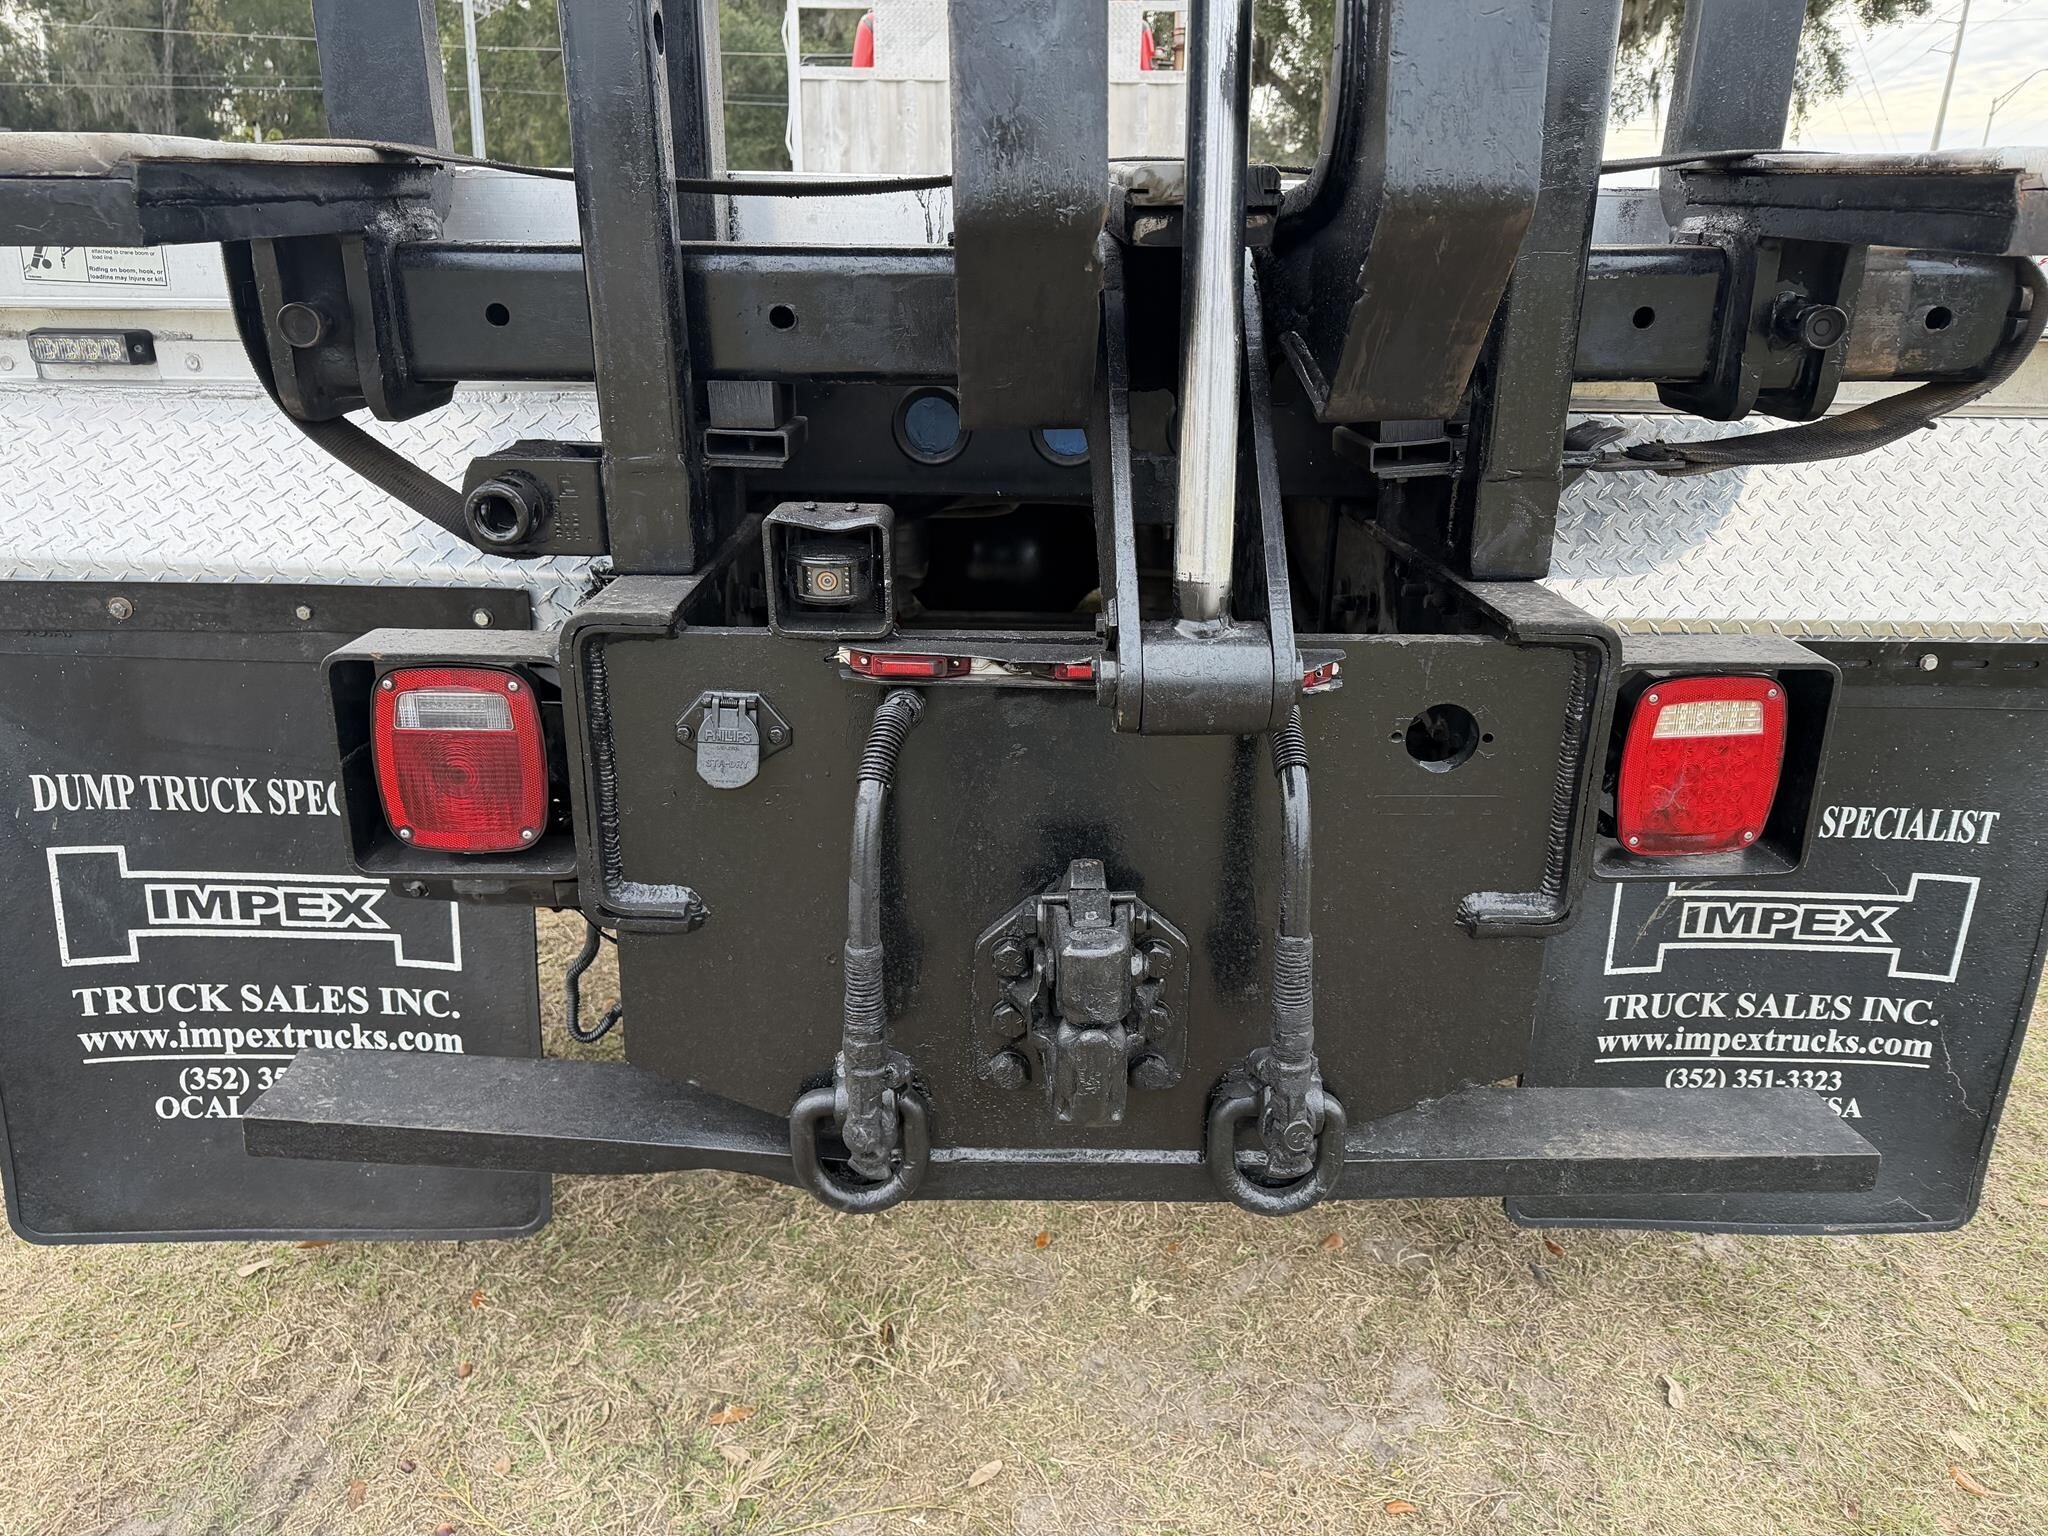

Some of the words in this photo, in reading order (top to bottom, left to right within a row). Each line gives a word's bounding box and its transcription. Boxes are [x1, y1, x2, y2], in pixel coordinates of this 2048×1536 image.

[705, 729, 752, 743] PHILLIPS
[29, 774, 135, 812] DUMP
[140, 775, 263, 814] TRUCK
[1818, 805, 2000, 845] SPECIALIST
[144, 884, 391, 930] IMPEX
[1678, 902, 1900, 943] IMPEX
[71, 983, 233, 1016] TRUCK
[240, 983, 370, 1015] SALES
[377, 987, 462, 1019] INC.
[1603, 992, 1729, 1021] TRUCK
[1735, 992, 1853, 1021] SALES
[1858, 996, 1940, 1026] INC.
[77, 1020, 464, 1055] www.impextrucks.com
[1596, 1026, 1933, 1058] www.impextrucks.com
[179, 1066, 250, 1095] (352)
[1665, 1068, 1727, 1089] (352)
[1732, 1068, 1843, 1092] 351-3323
[1821, 1097, 1863, 1118] SA
